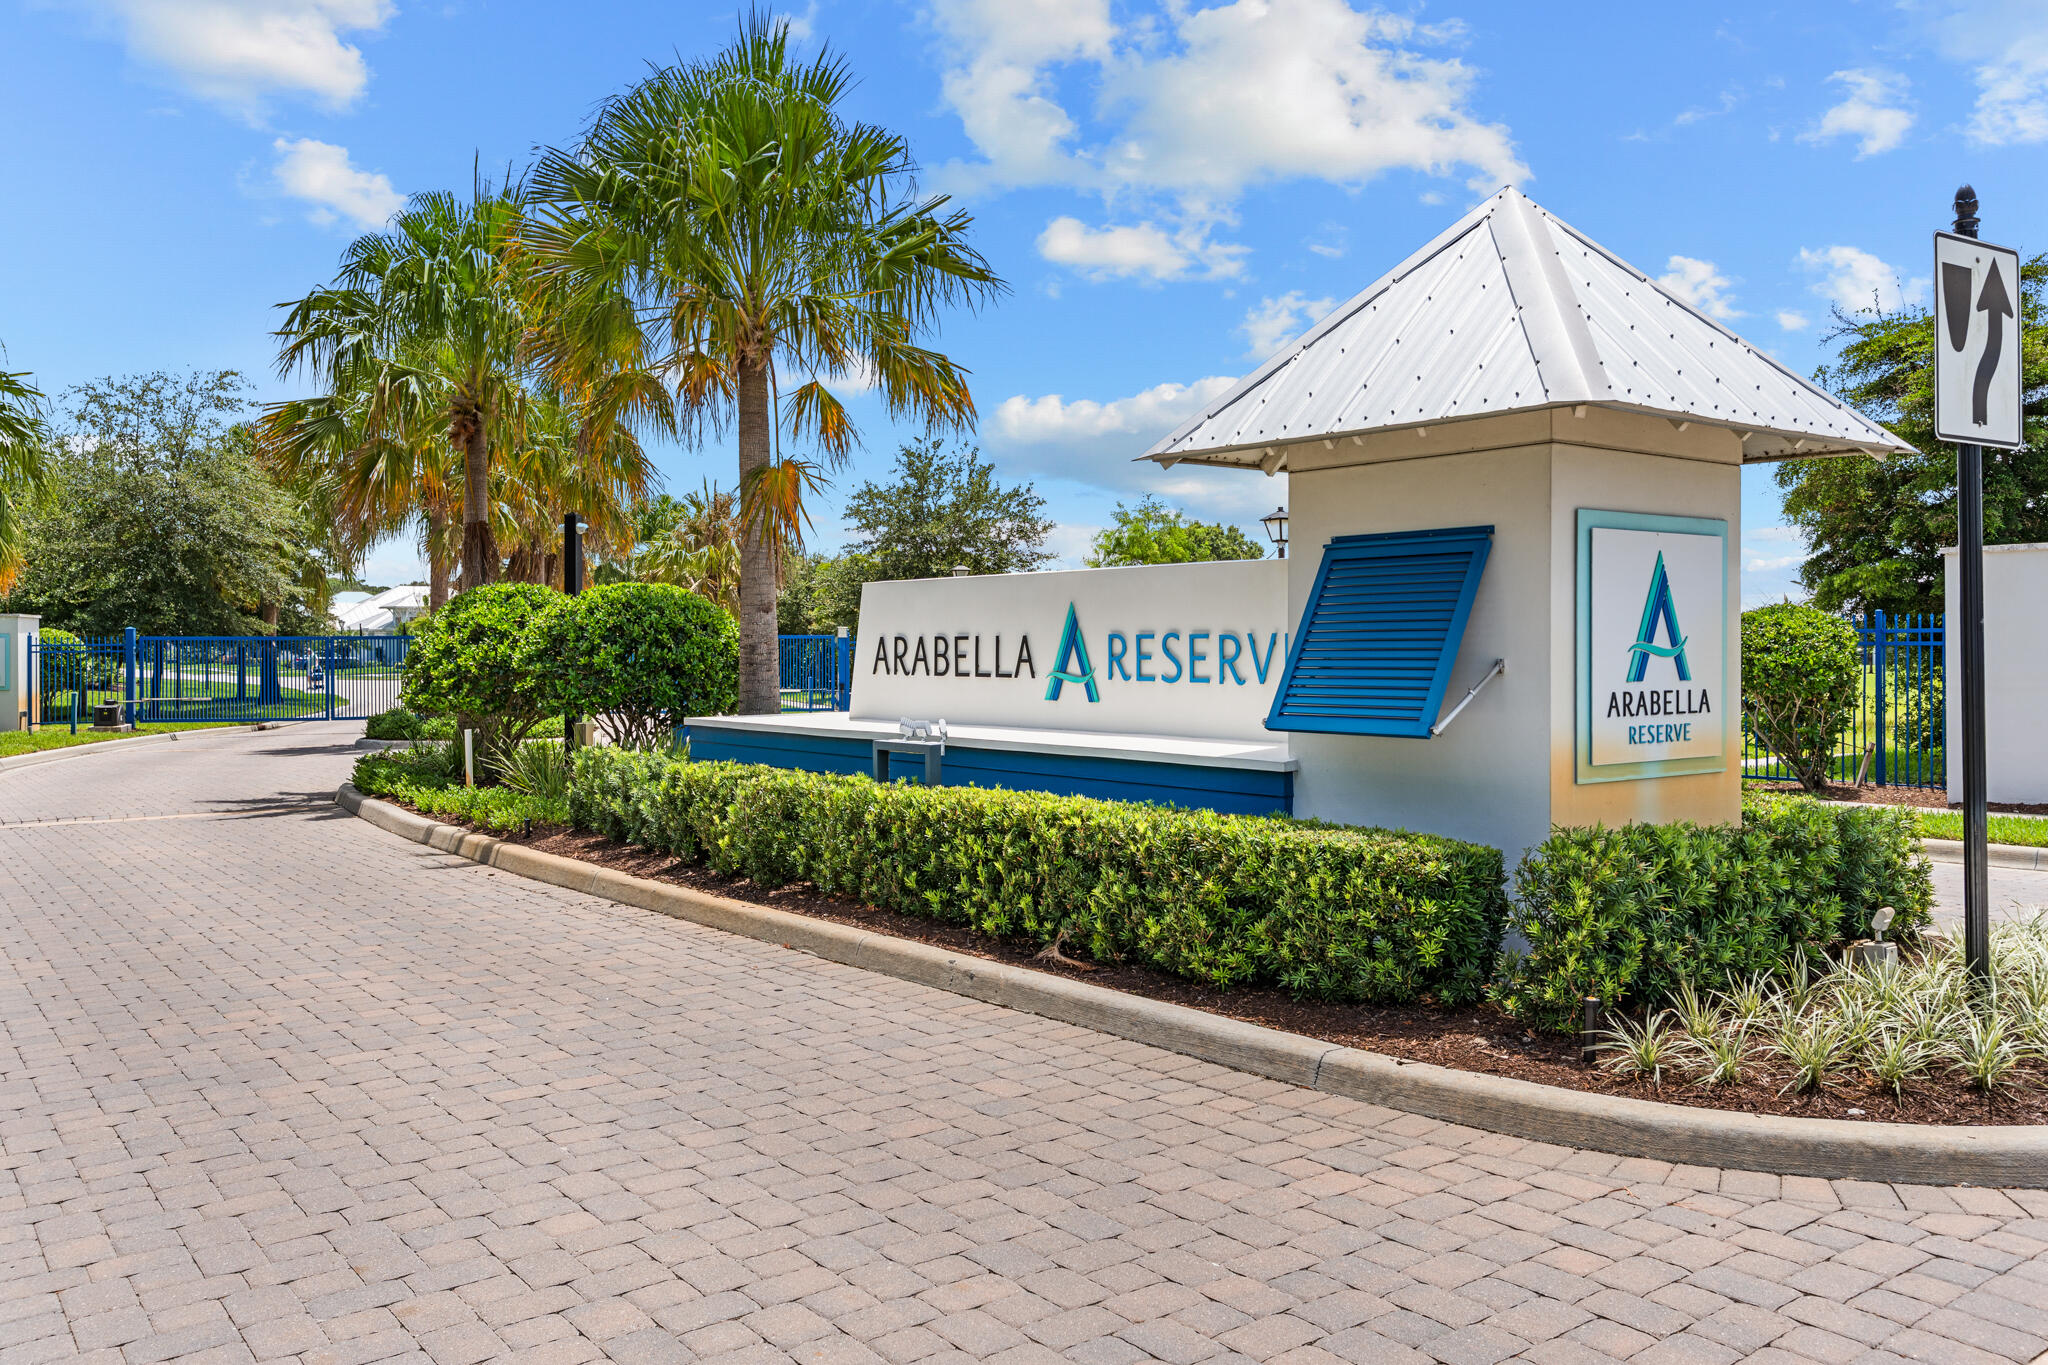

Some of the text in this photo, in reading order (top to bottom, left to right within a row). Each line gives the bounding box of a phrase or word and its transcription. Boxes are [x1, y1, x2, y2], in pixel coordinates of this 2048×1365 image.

[872, 635, 1036, 679] ARABELLA
[1107, 633, 1288, 685] RESERV
[1607, 689, 1711, 718] ARABELLA
[1628, 723, 1692, 745] RESERVE
